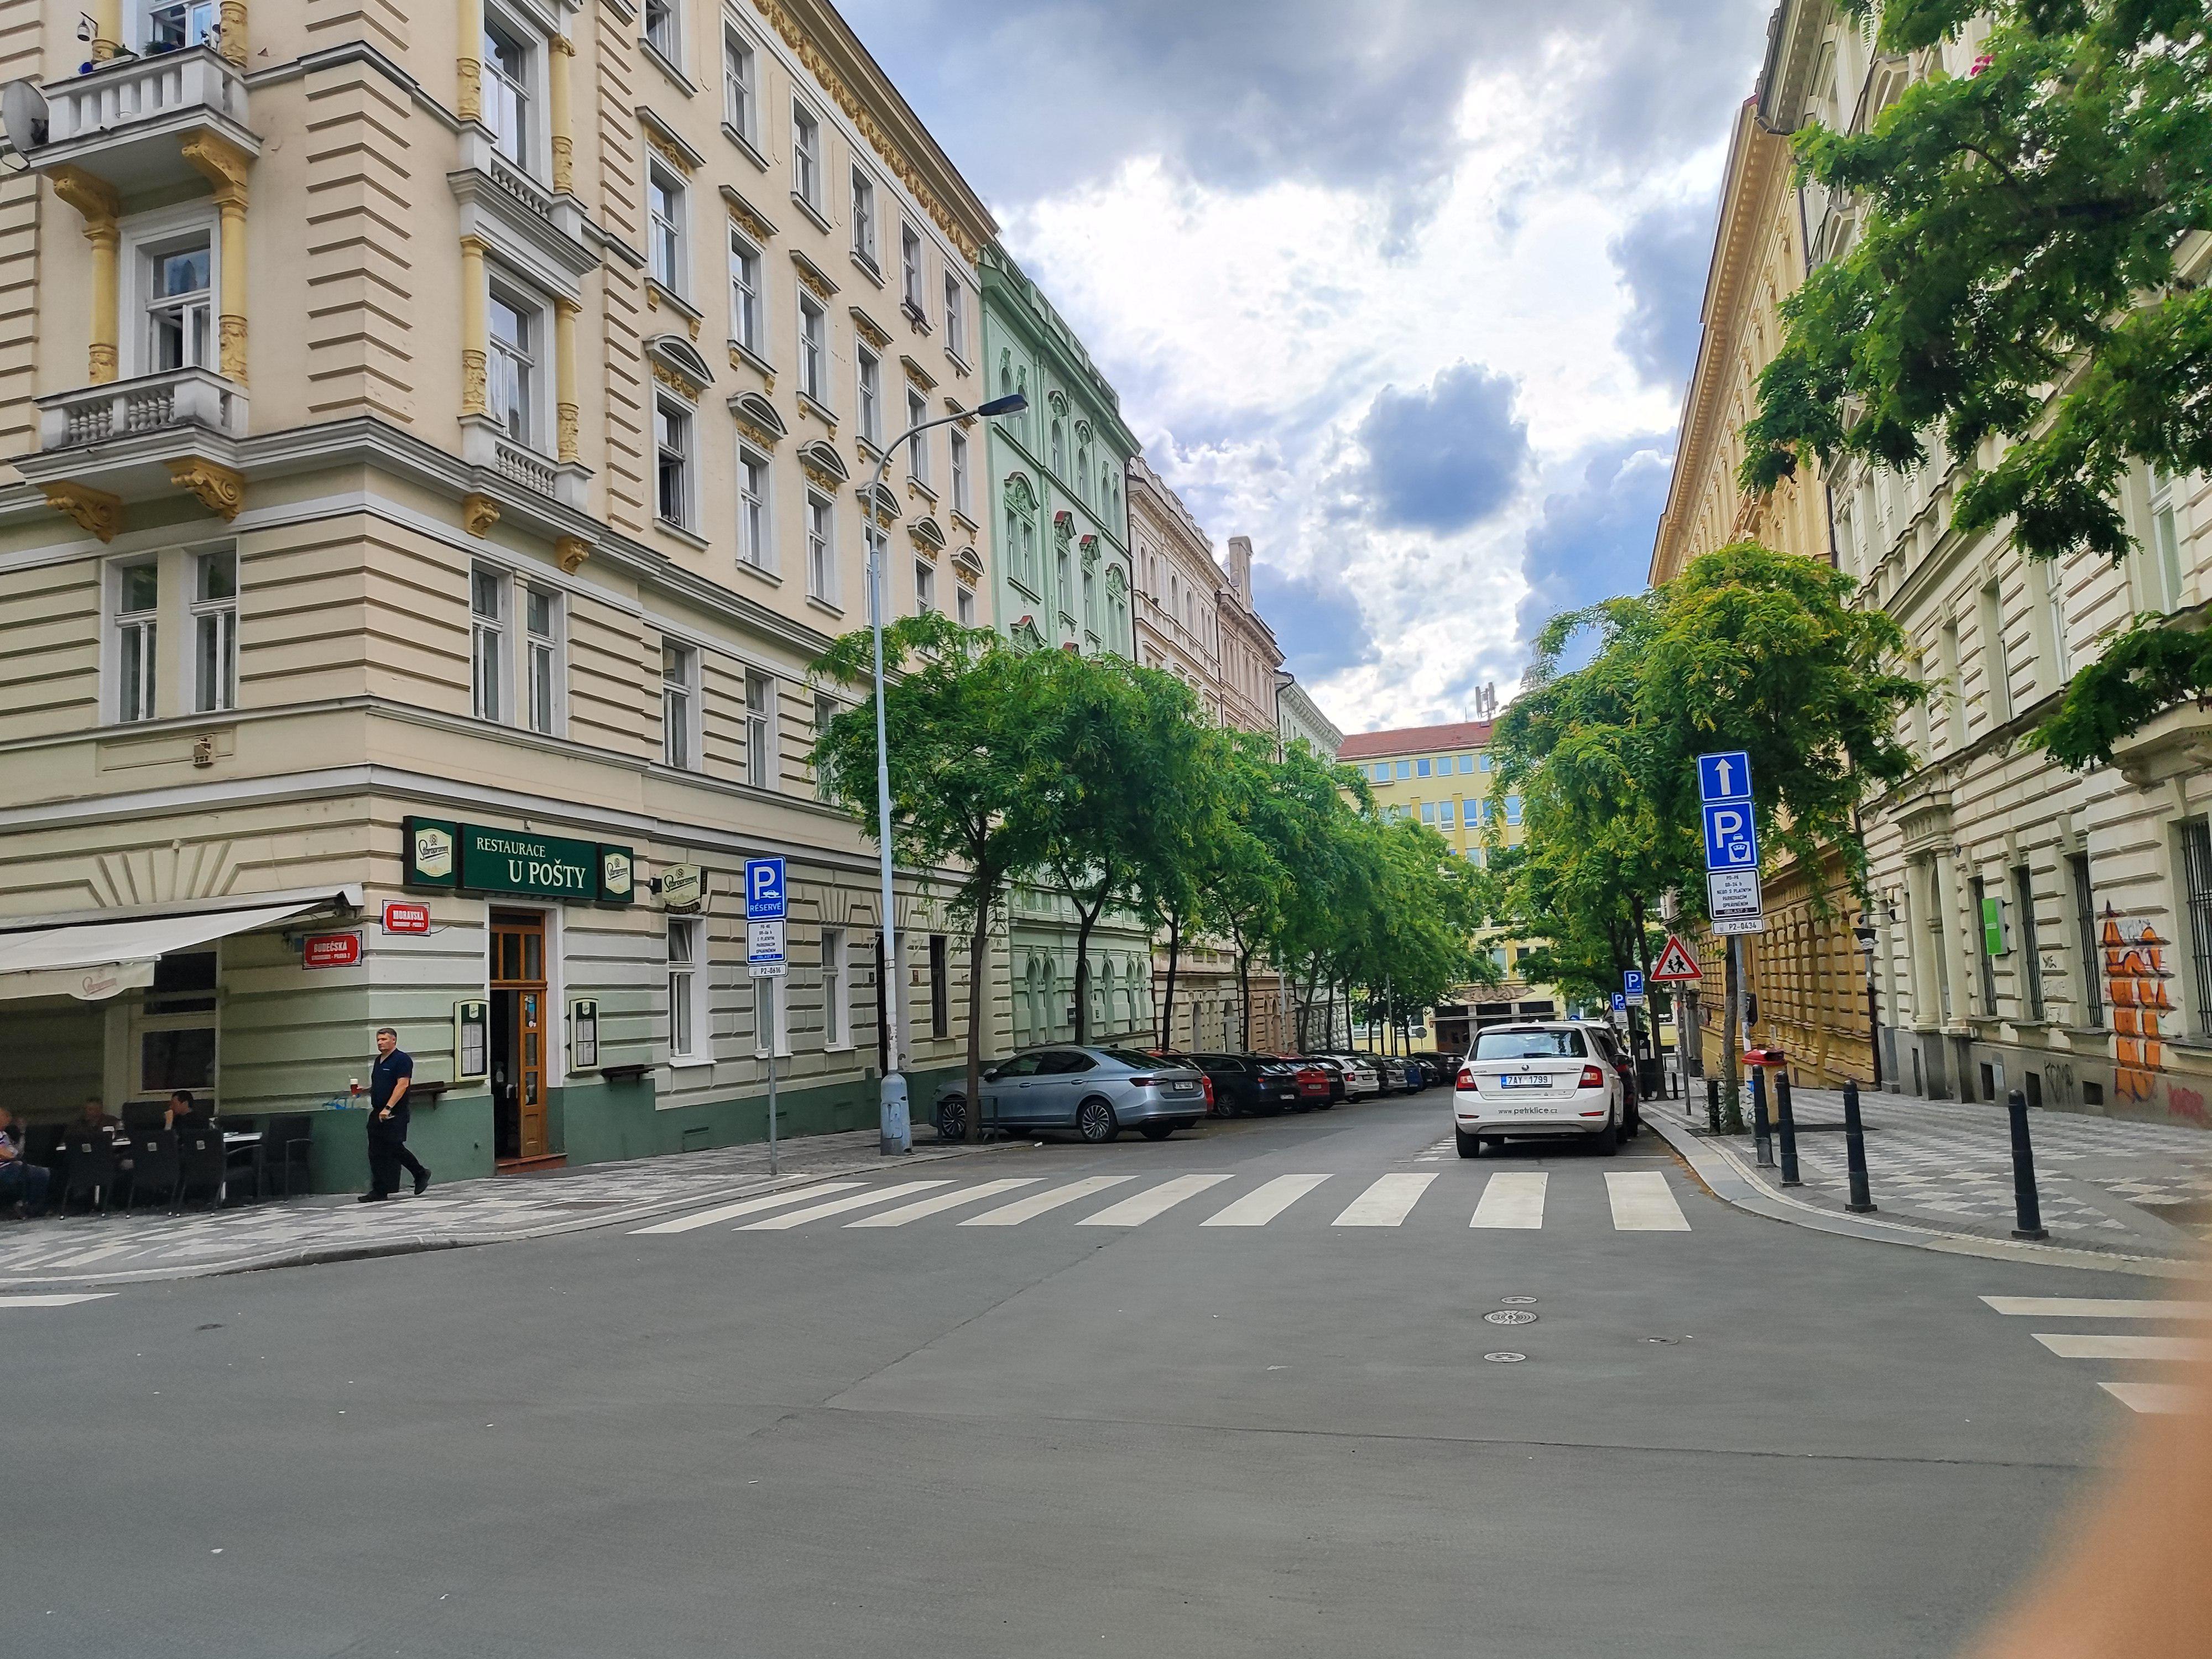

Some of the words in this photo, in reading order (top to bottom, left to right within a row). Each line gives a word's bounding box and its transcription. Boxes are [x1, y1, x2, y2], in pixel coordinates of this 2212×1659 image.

[1714, 811, 1743, 848] P
[477, 837, 546, 857] RESTAURACE
[508, 859, 523, 883] U
[528, 858, 586, 889] POŠTY
[754, 866, 775, 900] P
[664, 874, 698, 893] Staropramen
[750, 901, 782, 912] RÉSERVÉ
[1628, 974, 1639, 988] P
[1615, 994, 1624, 1005] P
[1529, 1076, 1548, 1084] 1799
